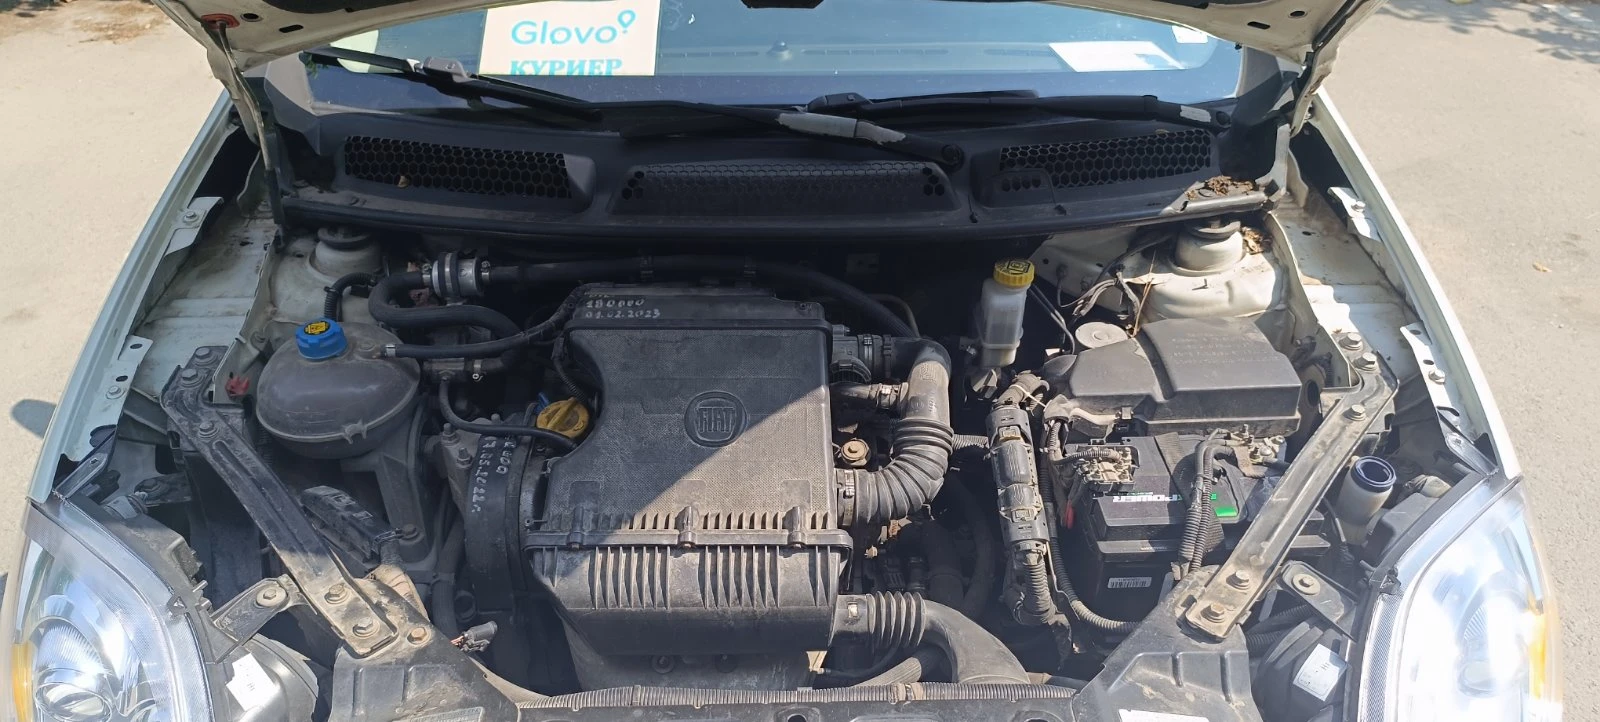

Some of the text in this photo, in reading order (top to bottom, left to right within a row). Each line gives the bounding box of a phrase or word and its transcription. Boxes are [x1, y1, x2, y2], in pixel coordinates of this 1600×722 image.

[510, 20, 617, 45] Glovo
[510, 59, 623, 76] КУРИЕР
[698, 406, 736, 434] FIAT
